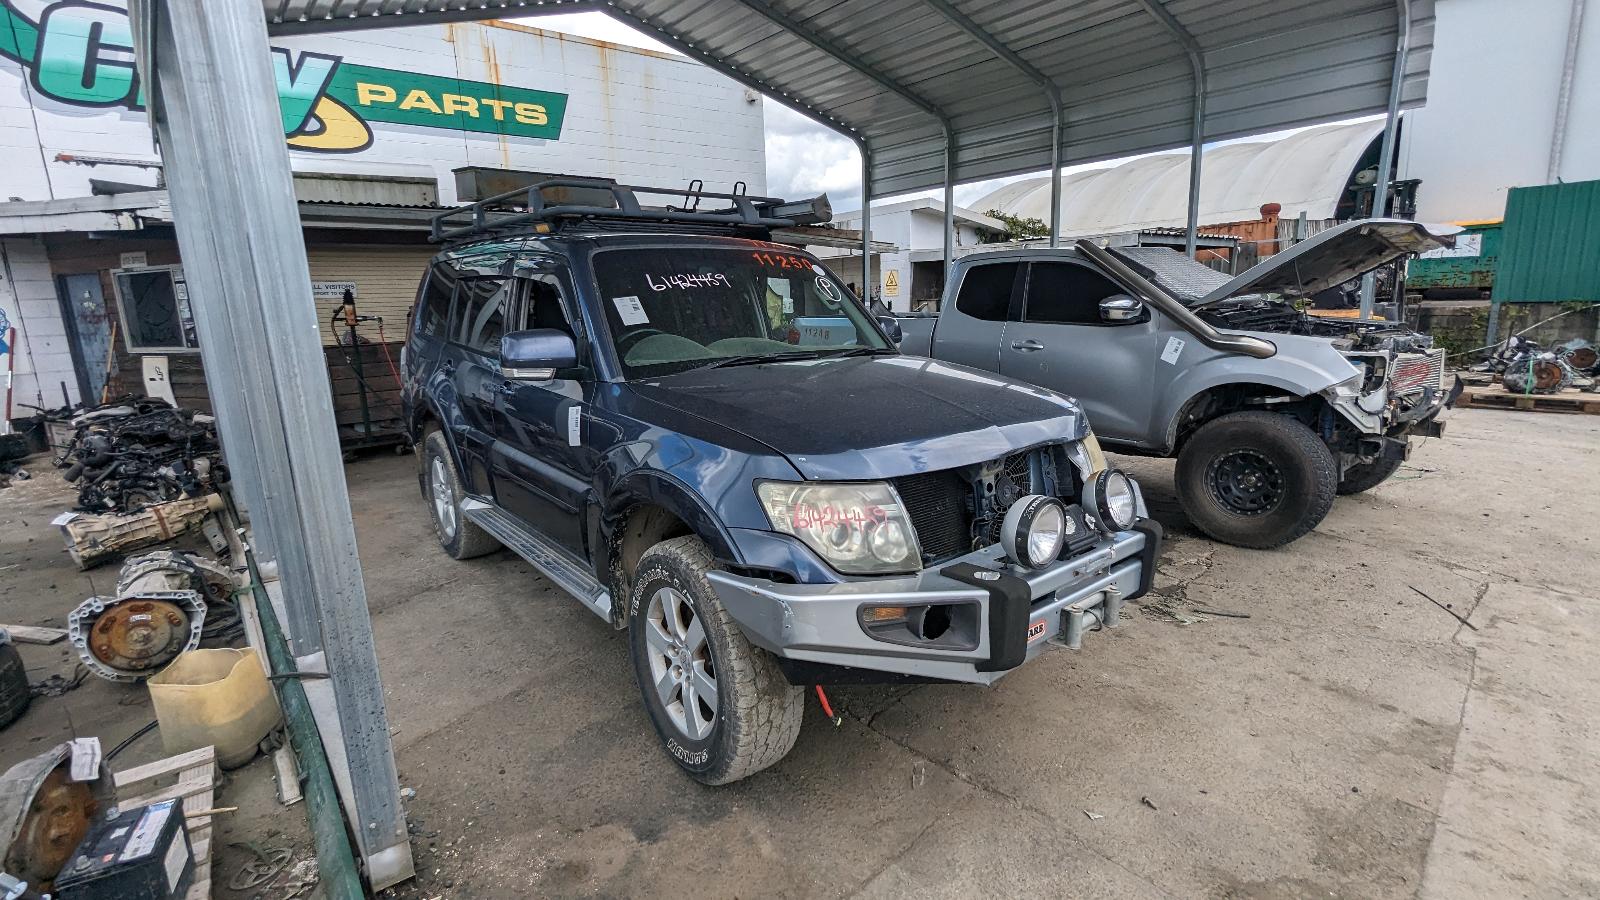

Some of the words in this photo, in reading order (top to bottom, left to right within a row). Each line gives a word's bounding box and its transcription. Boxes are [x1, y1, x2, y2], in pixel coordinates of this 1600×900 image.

[356, 82, 548, 126] PARTS
[752, 252, 813, 270] 11250
[645, 272, 732, 292] 61424459
